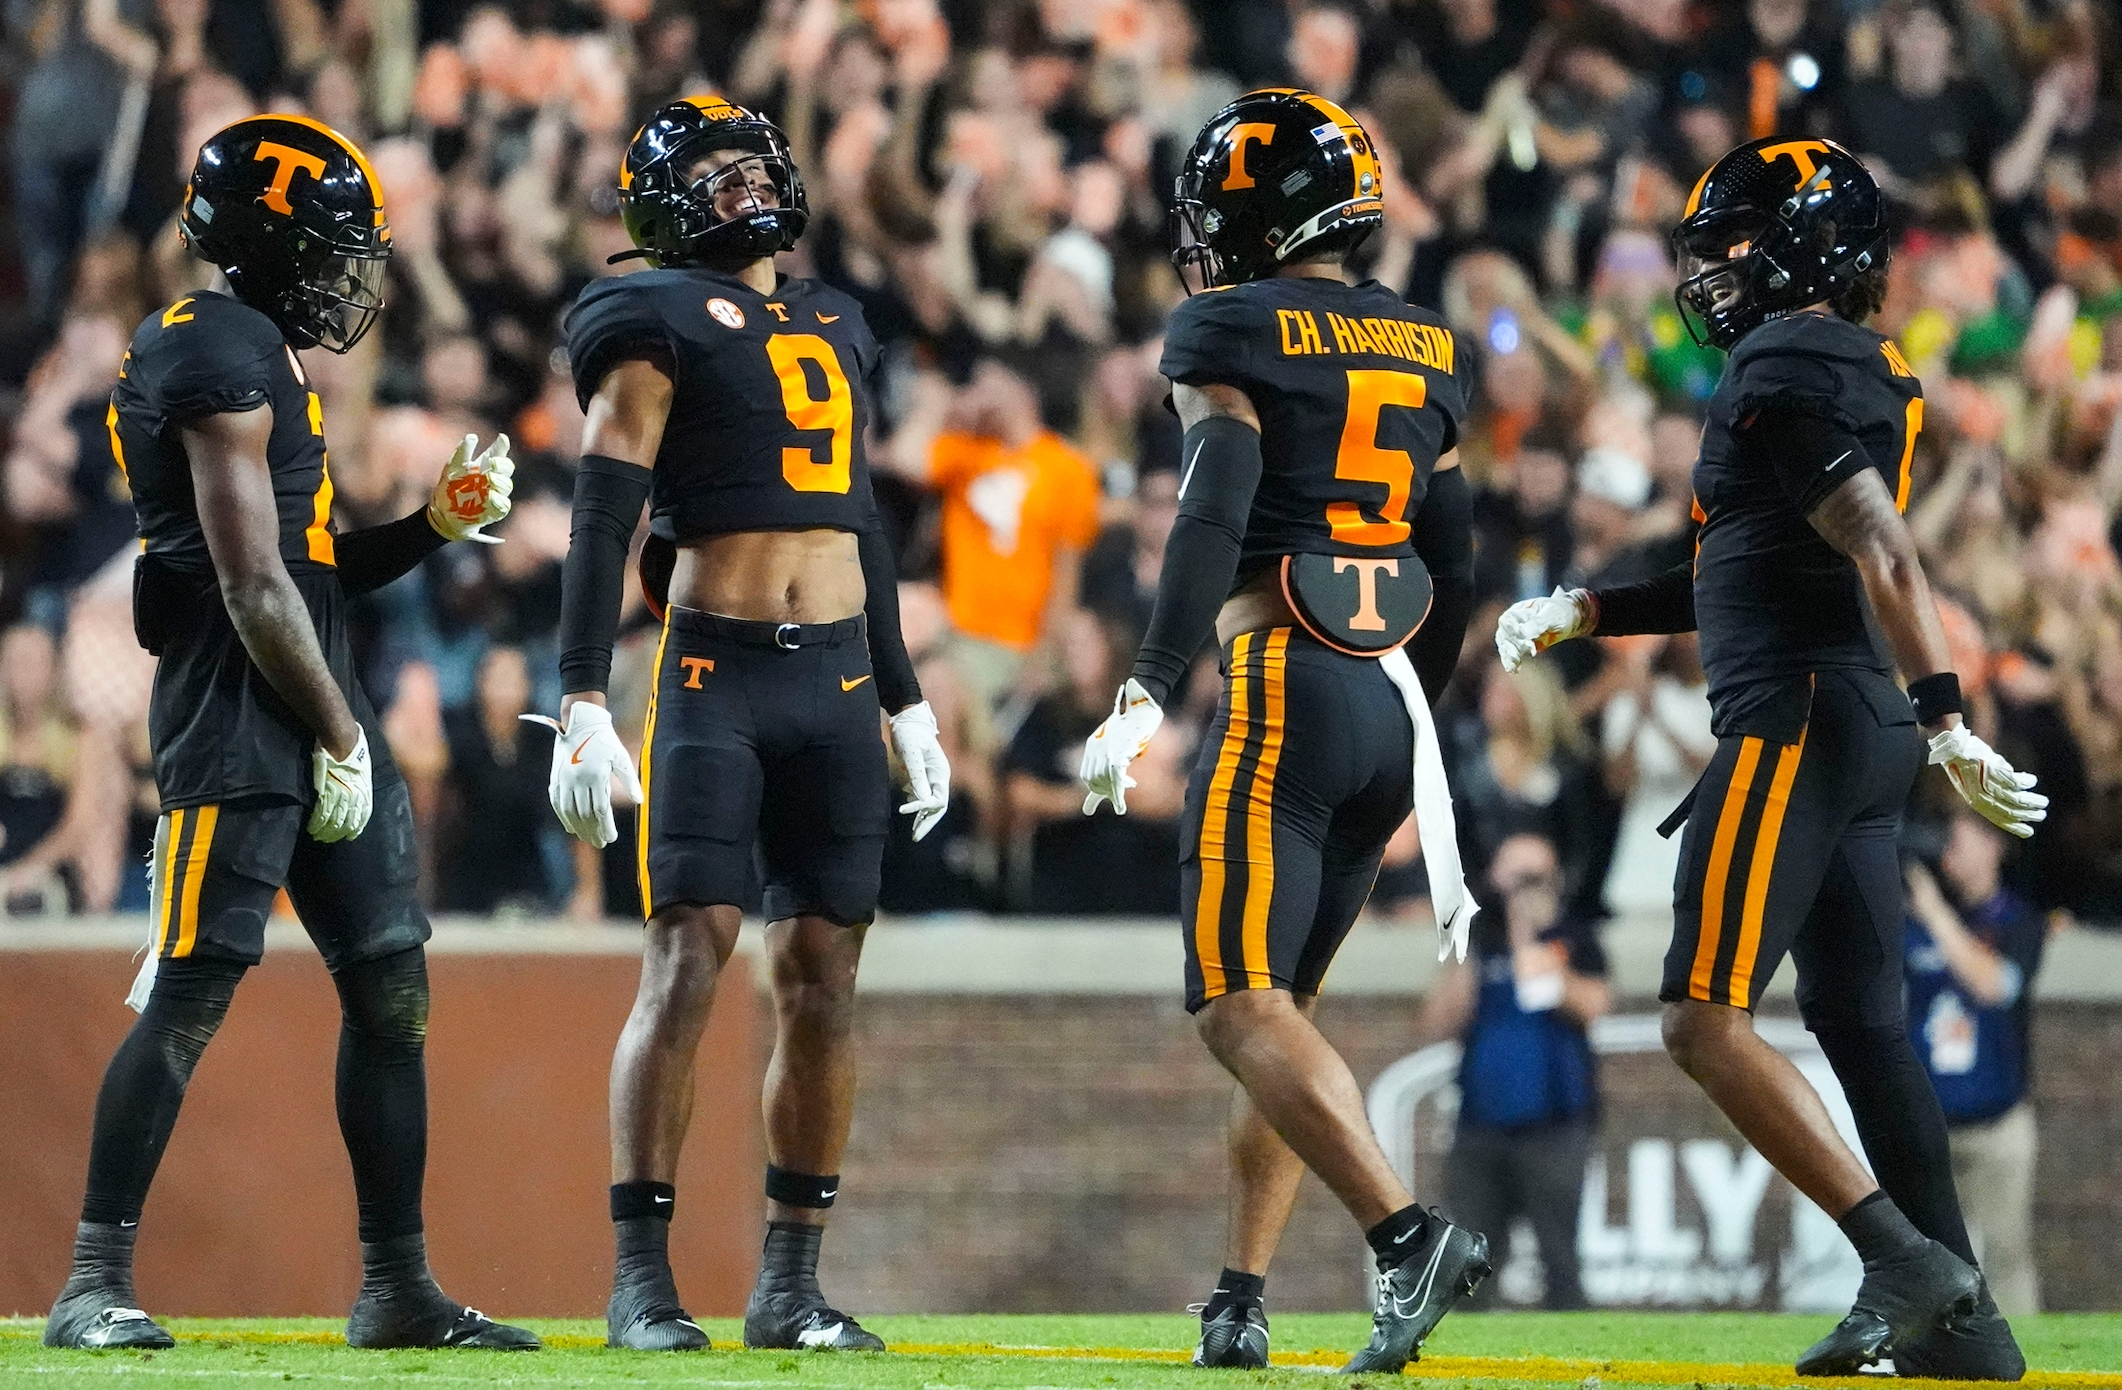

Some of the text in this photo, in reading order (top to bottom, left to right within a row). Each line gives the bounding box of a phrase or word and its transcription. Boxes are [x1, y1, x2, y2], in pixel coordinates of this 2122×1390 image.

[707, 109, 744, 121] VOLS
[253, 141, 328, 217] T
[1222, 122, 1277, 192] T
[1758, 140, 1832, 192] T
[708, 299, 745, 328] SEC
[765, 302, 790, 322] T
[1276, 309, 1455, 376] CH. HARRISON
[765, 333, 853, 495] 9
[1326, 369, 1427, 546] 5
[1333, 556, 1399, 632] T
[681, 656, 715, 690] T
